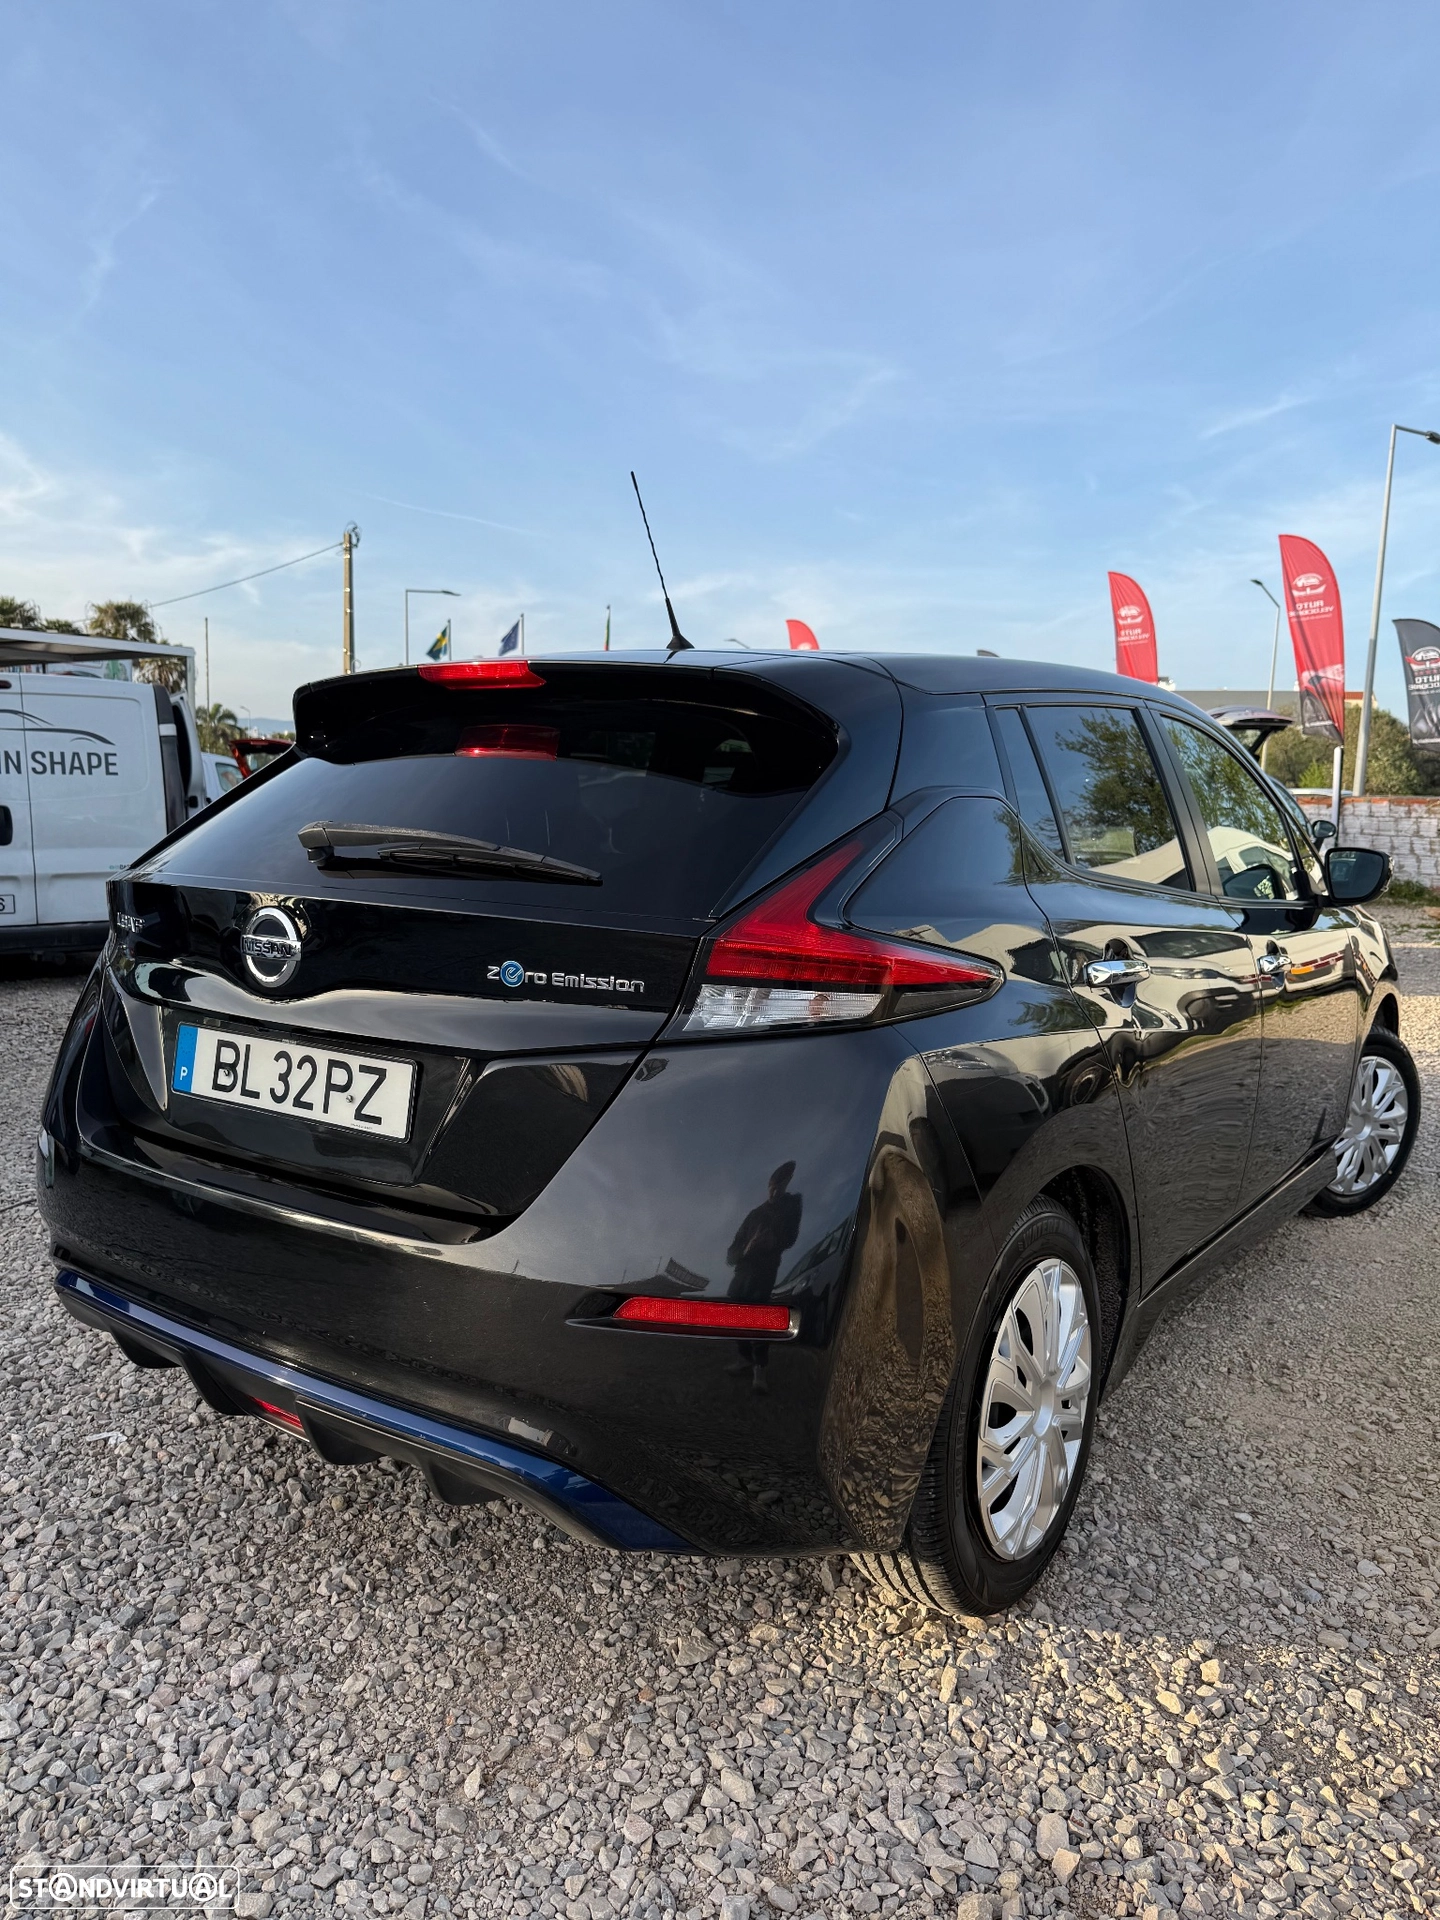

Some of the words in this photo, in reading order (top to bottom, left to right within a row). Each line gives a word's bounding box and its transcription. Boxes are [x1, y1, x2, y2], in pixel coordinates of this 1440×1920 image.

[0, 750, 22, 774] N
[31, 750, 119, 776] SHAPE
[244, 938, 292, 957] NISSAN
[551, 972, 645, 993] Emission
[179, 1066, 188, 1081] P
